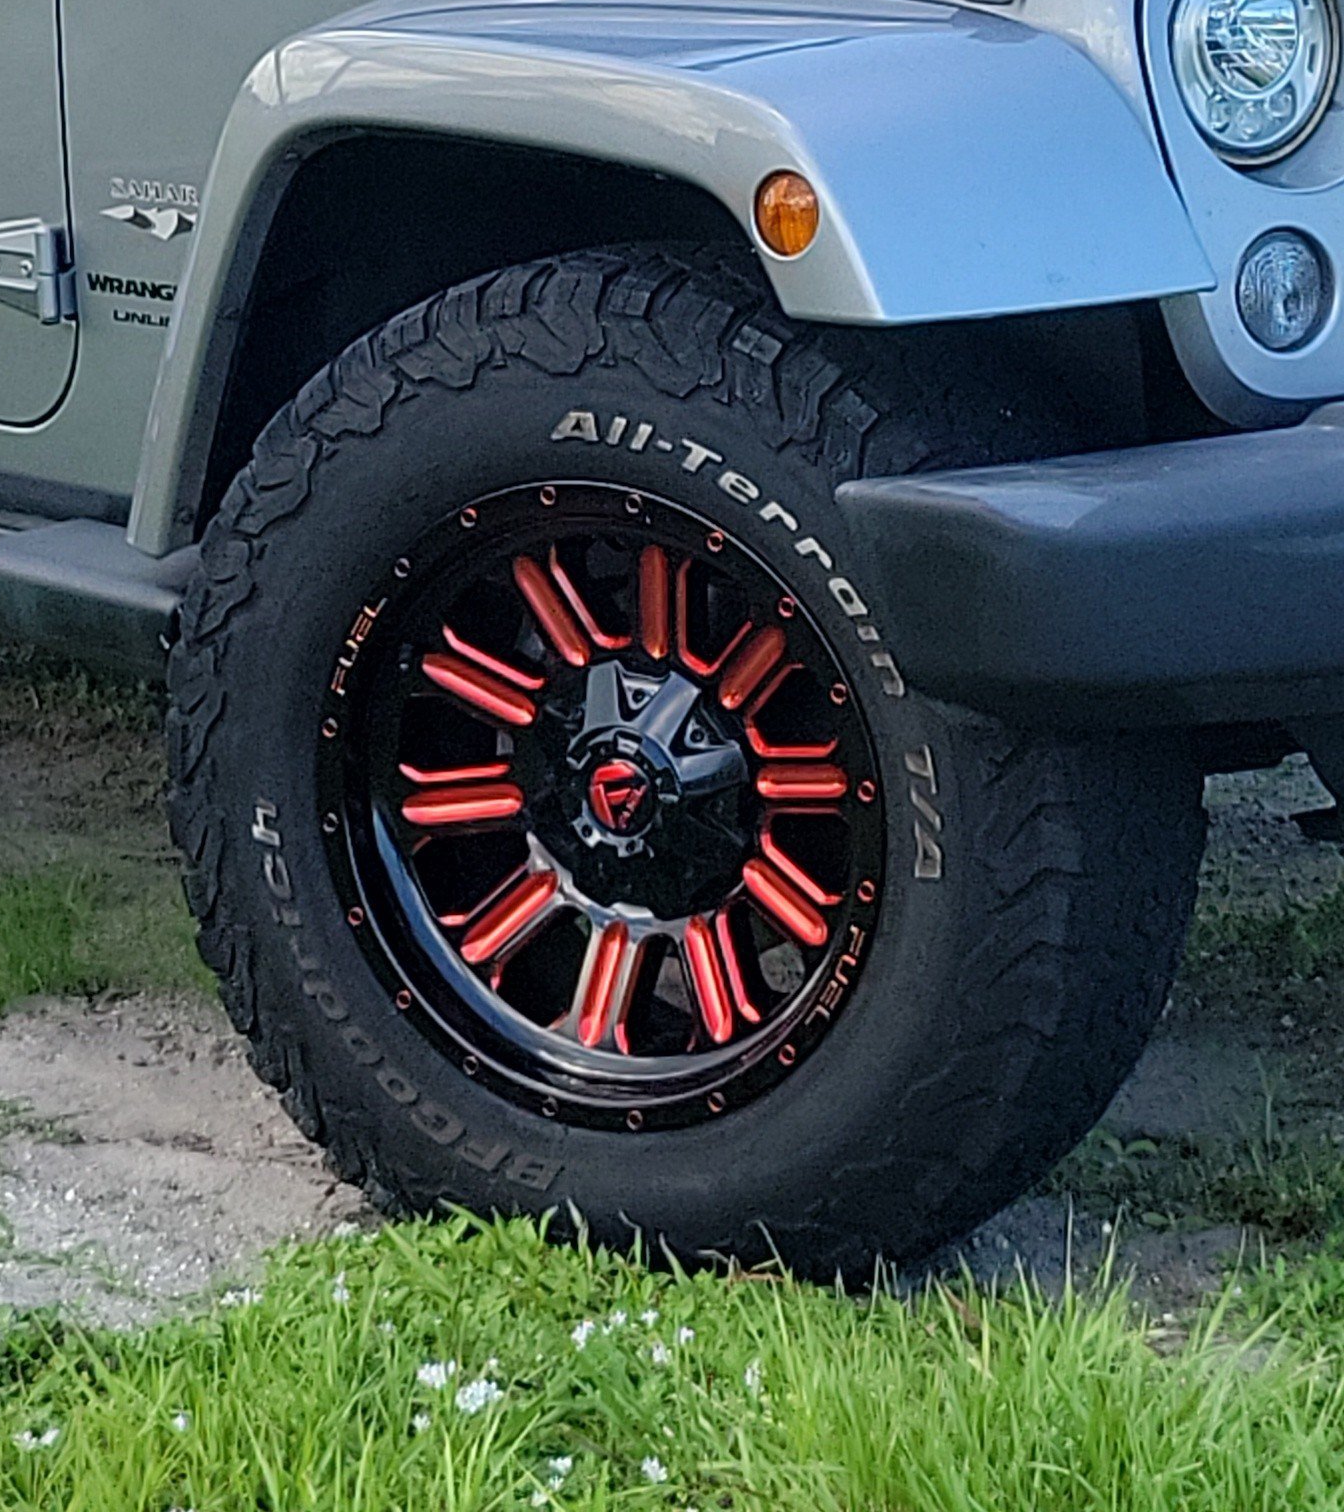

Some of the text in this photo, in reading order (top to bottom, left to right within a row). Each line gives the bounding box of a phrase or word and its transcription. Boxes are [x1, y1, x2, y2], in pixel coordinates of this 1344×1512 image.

[113, 309, 171, 328] UNLI
[330, 596, 389, 698] FUEL
[903, 743, 943, 879] T/A
[803, 923, 866, 1027] FUEL
